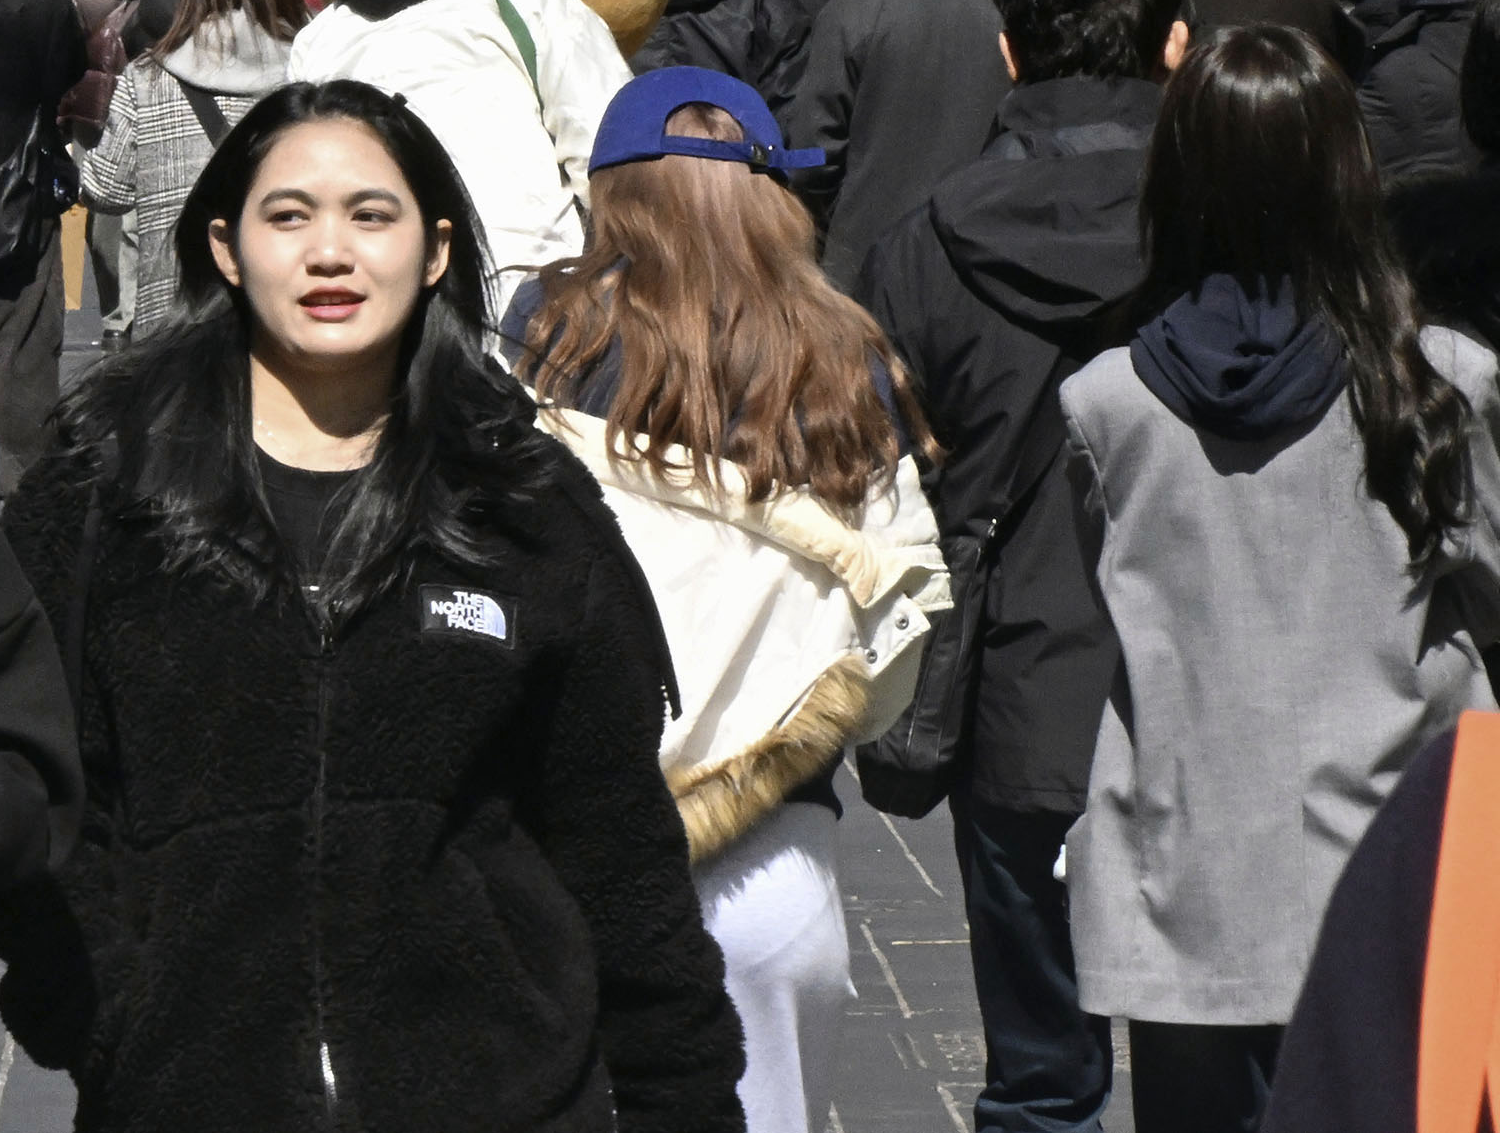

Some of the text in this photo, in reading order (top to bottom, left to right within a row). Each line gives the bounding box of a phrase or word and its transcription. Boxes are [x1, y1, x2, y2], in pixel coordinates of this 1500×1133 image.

[453, 591, 485, 607] THE
[431, 600, 482, 619] NORTH
[447, 614, 486, 633] FACE
